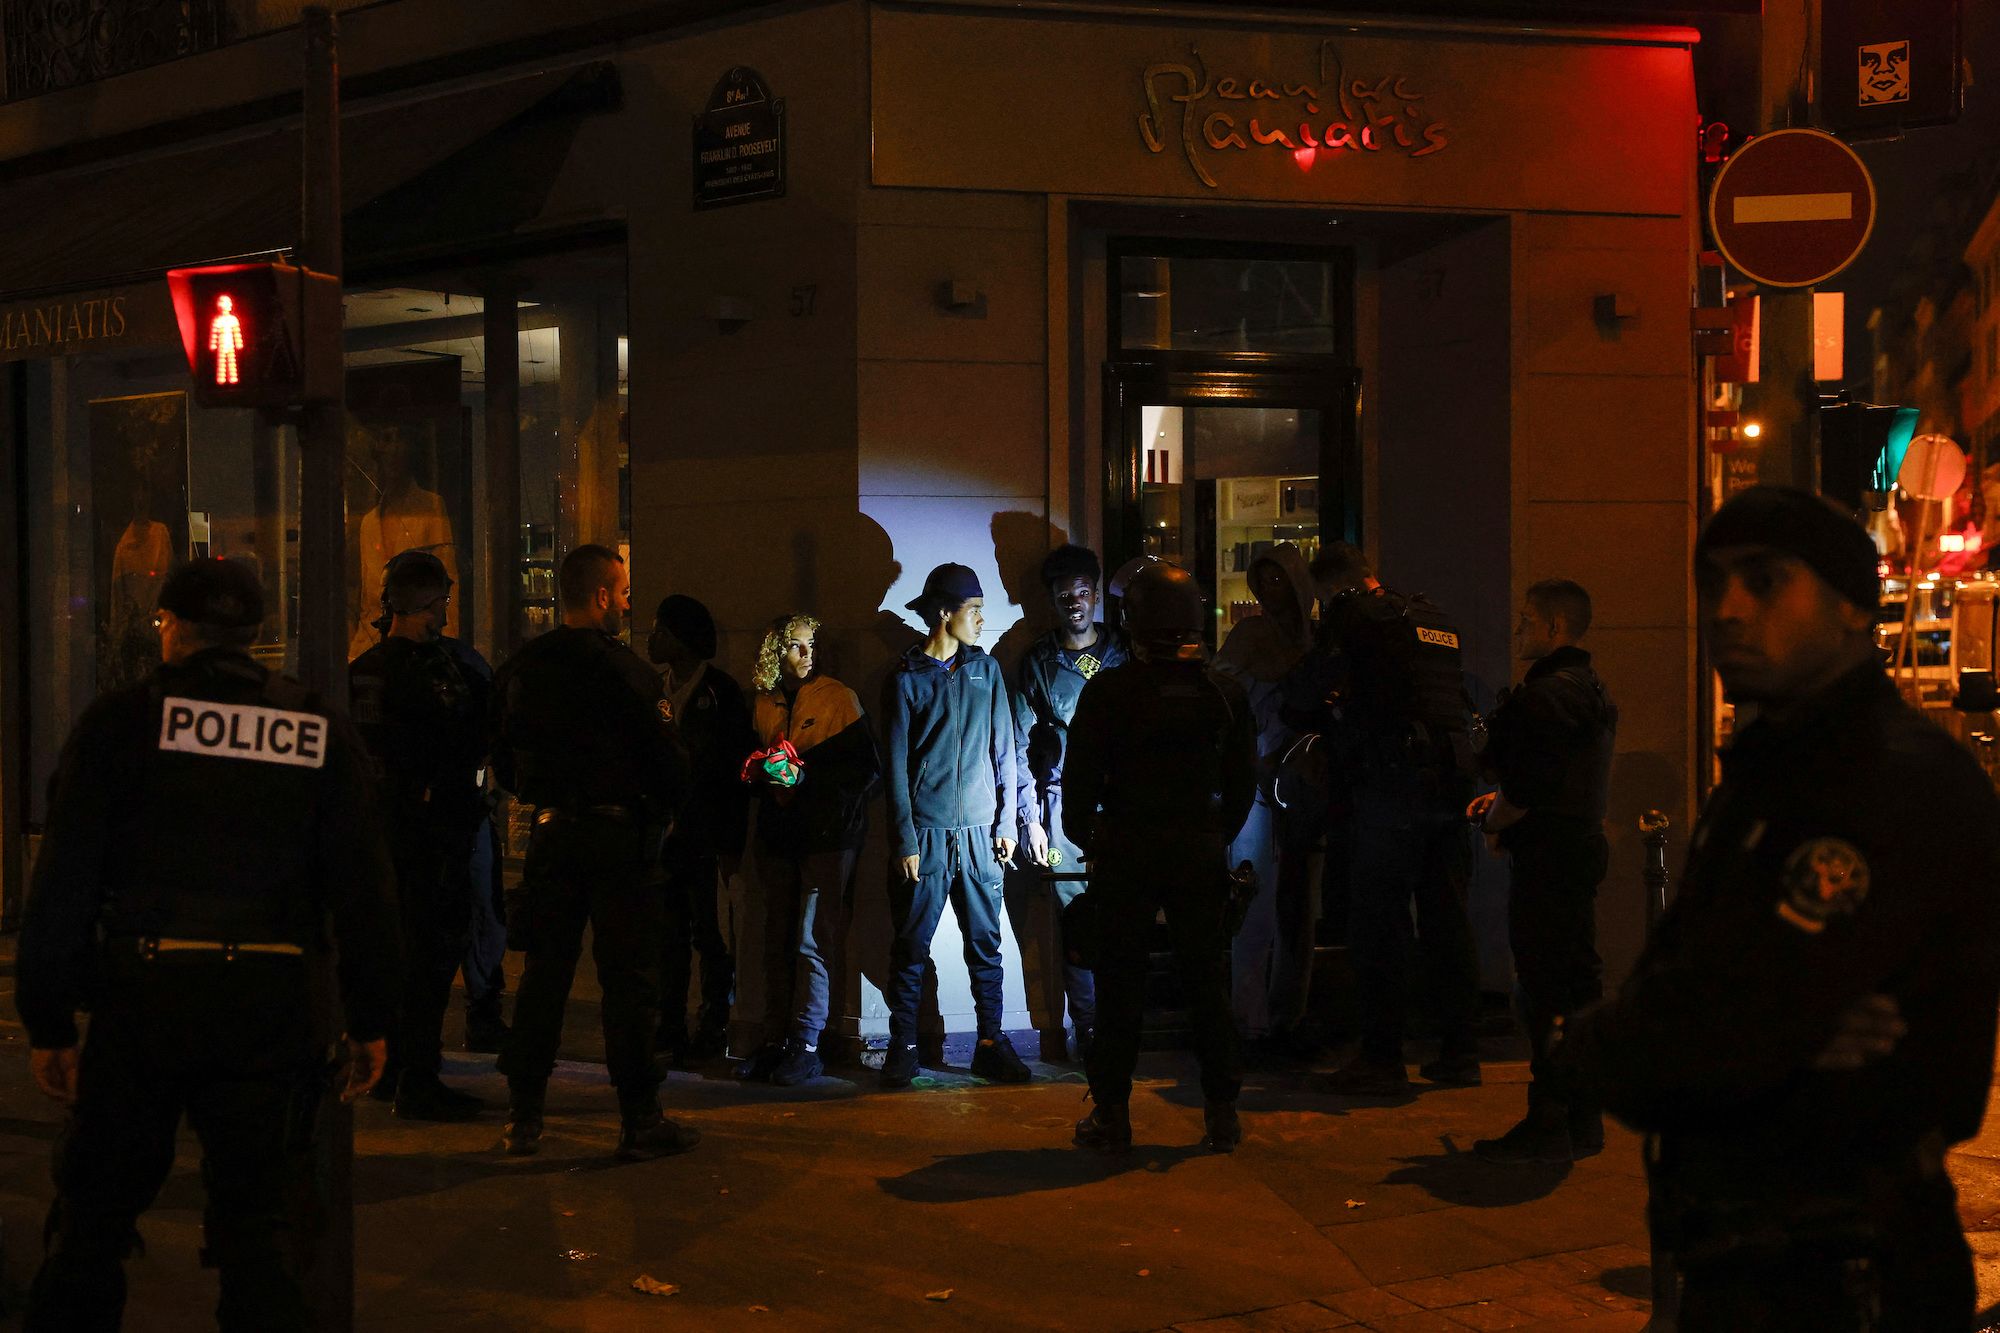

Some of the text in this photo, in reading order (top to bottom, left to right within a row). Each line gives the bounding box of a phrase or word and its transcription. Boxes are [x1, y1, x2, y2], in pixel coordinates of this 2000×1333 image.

[1170, 46, 1318, 100] Jean
[725, 122, 752, 139] AVENUE
[1136, 62, 1449, 189] Maniatis
[701, 149, 731, 165] FRANKLIN
[739, 138, 777, 158] ROOSEVELT
[1422, 629, 1454, 646] POLICE
[167, 706, 320, 759] POLICE
